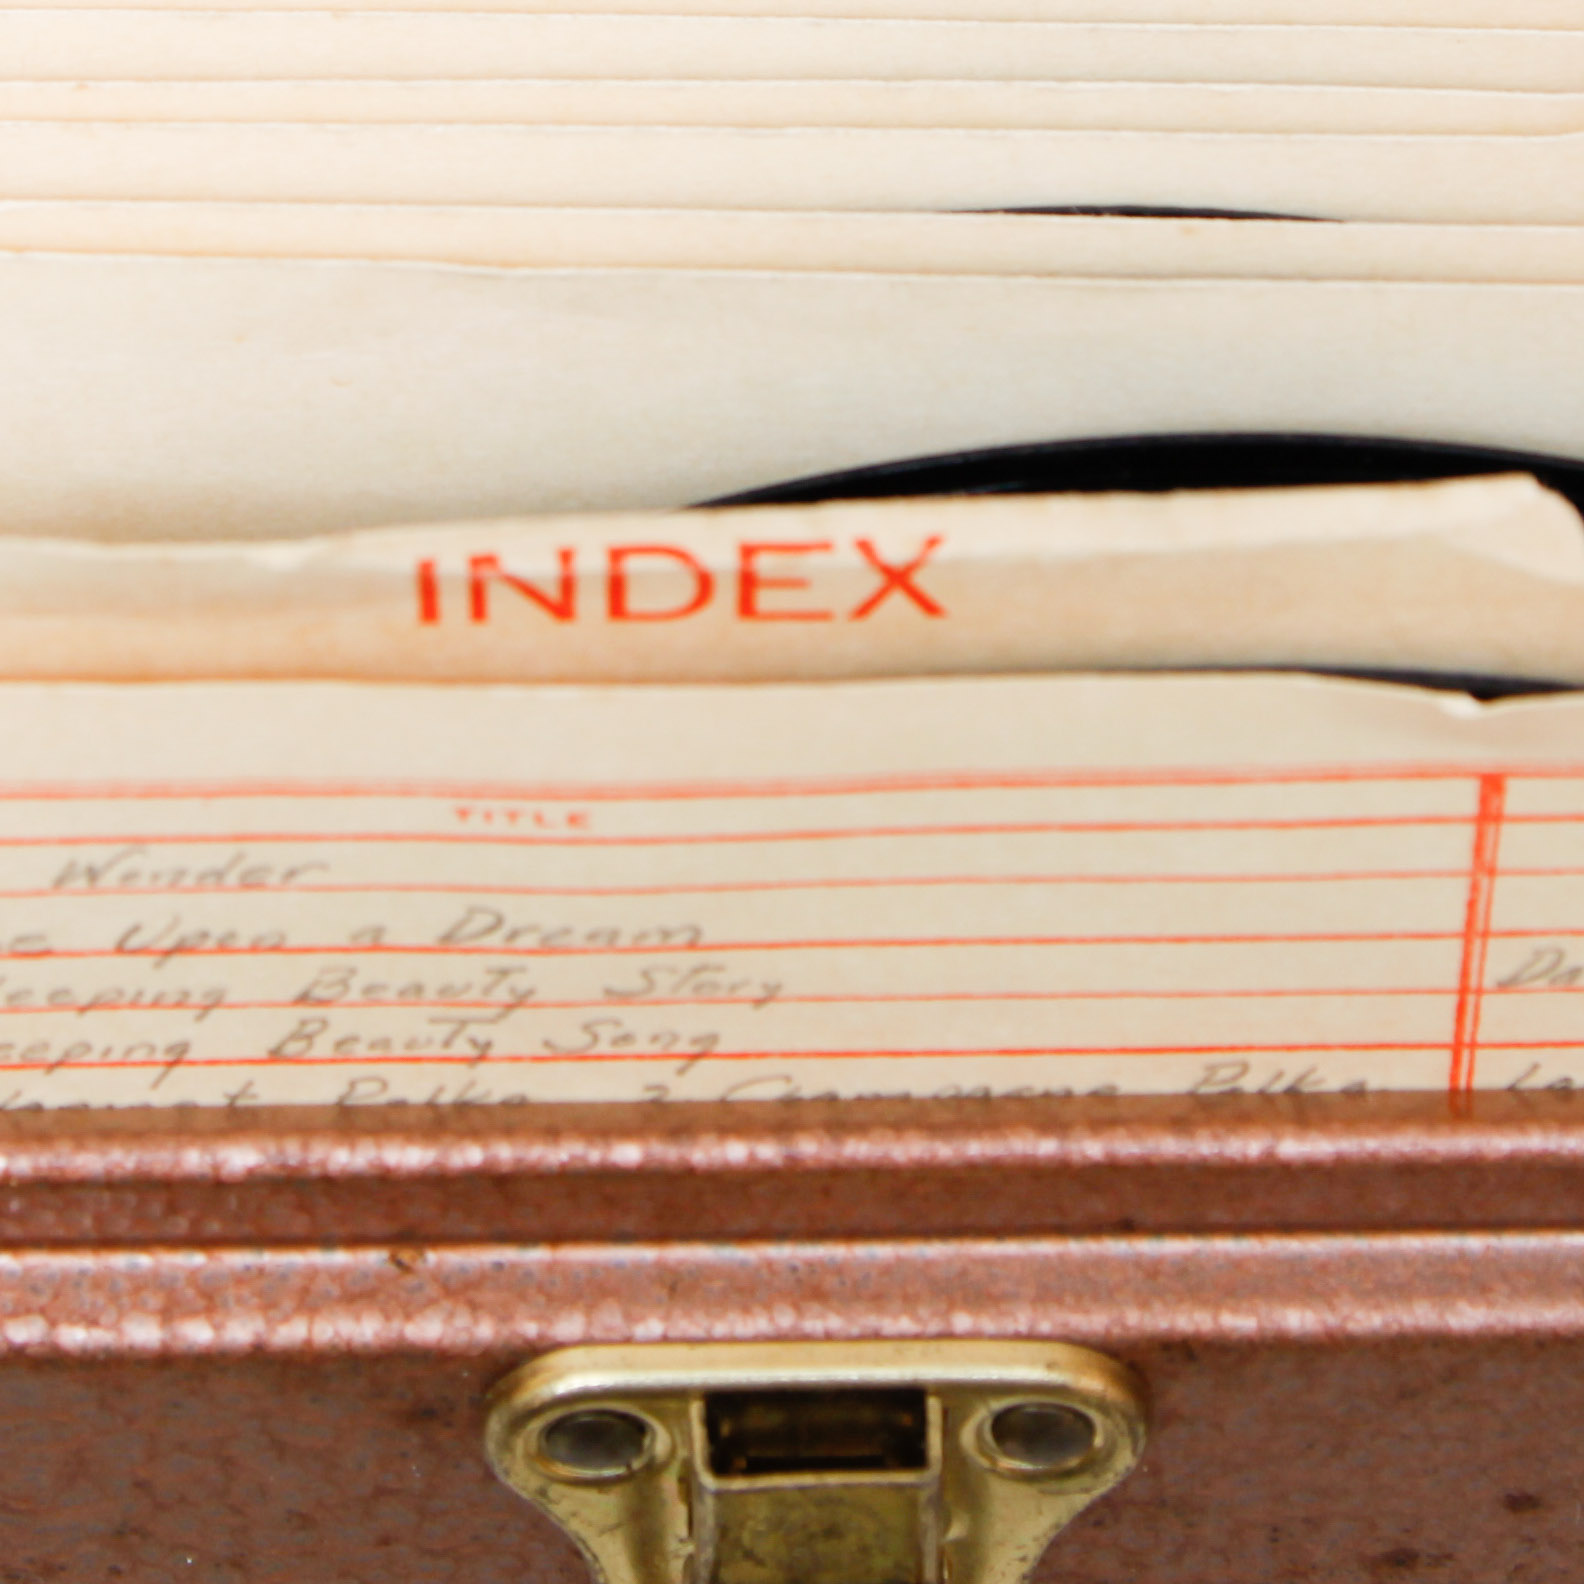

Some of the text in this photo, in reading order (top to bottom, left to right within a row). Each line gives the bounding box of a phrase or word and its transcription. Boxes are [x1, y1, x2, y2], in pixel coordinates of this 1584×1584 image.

[414, 531, 950, 629] INDEX
[452, 805, 594, 830] TITLE
[435, 906, 704, 948] Dream
[540, 1018, 722, 1078] Song
